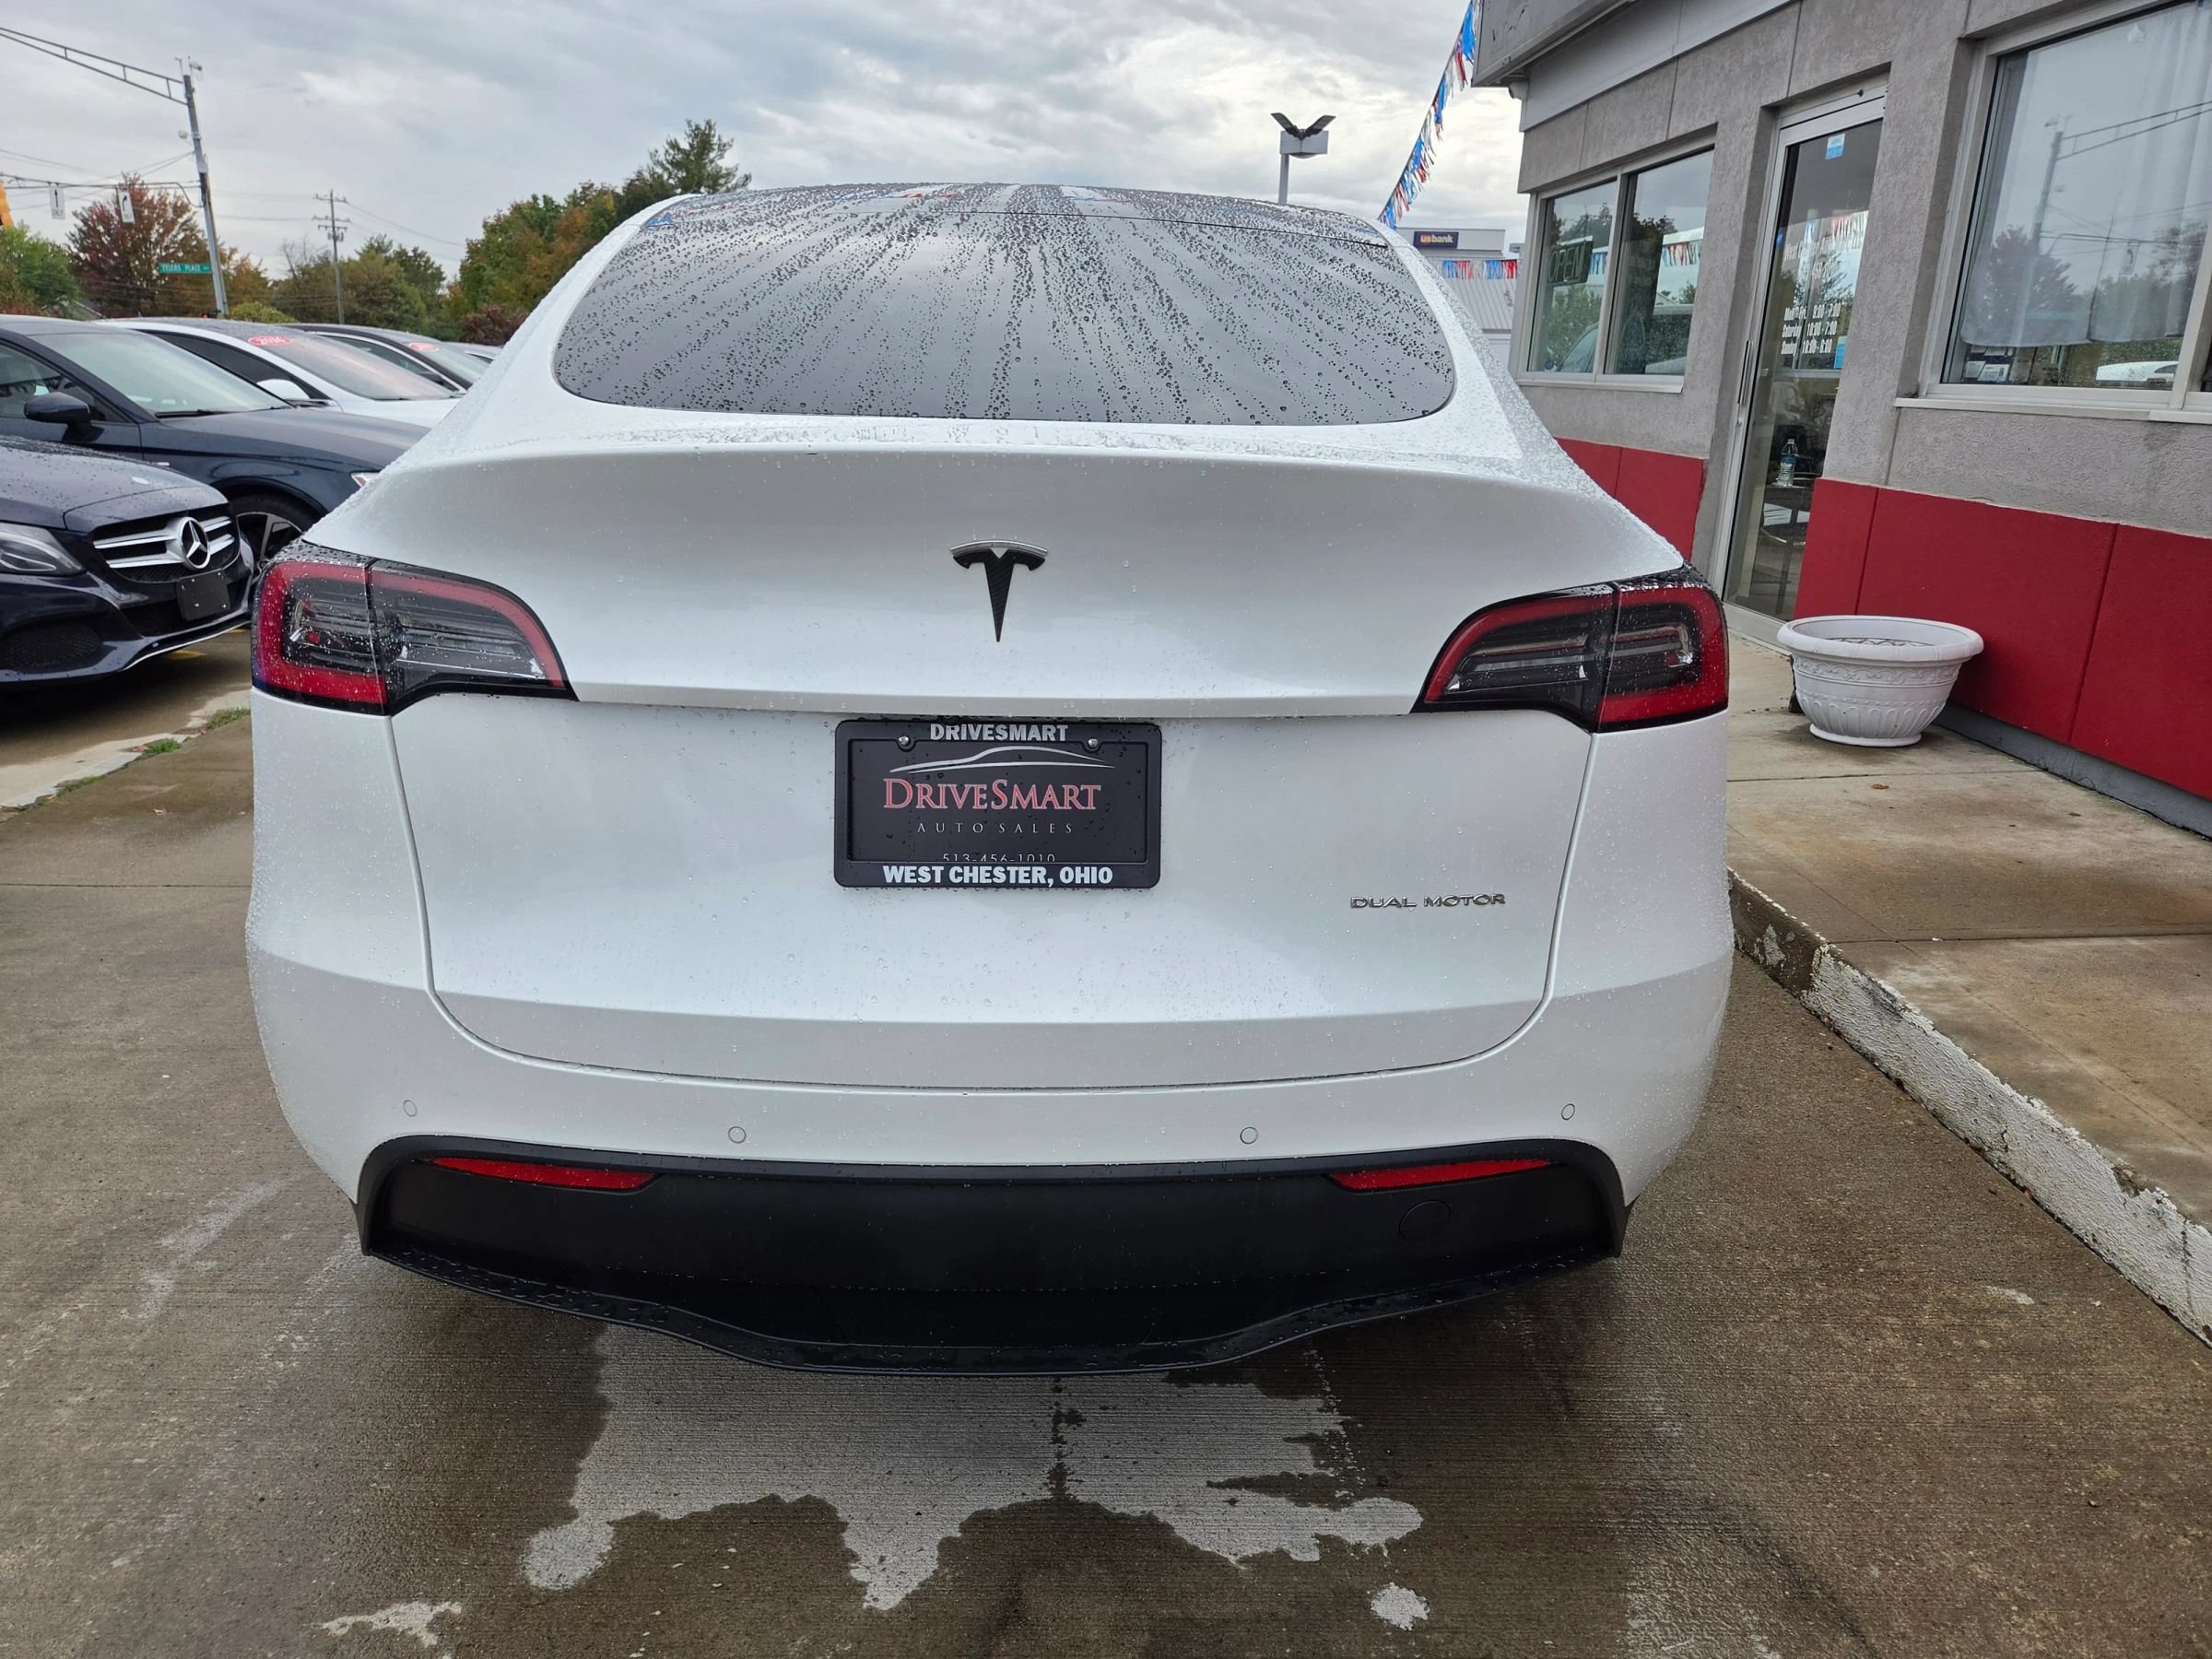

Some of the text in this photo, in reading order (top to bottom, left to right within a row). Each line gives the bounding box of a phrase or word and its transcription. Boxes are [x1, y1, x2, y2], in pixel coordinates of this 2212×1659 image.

[1548, 241, 1585, 282] OPEN
[930, 724, 1068, 742] DRIVESMART
[917, 822, 1072, 834] AUTO SALES
[883, 865, 1113, 888] WEST CHESTER, OHIO
[1350, 894, 1506, 908] DUAL MOTOR
